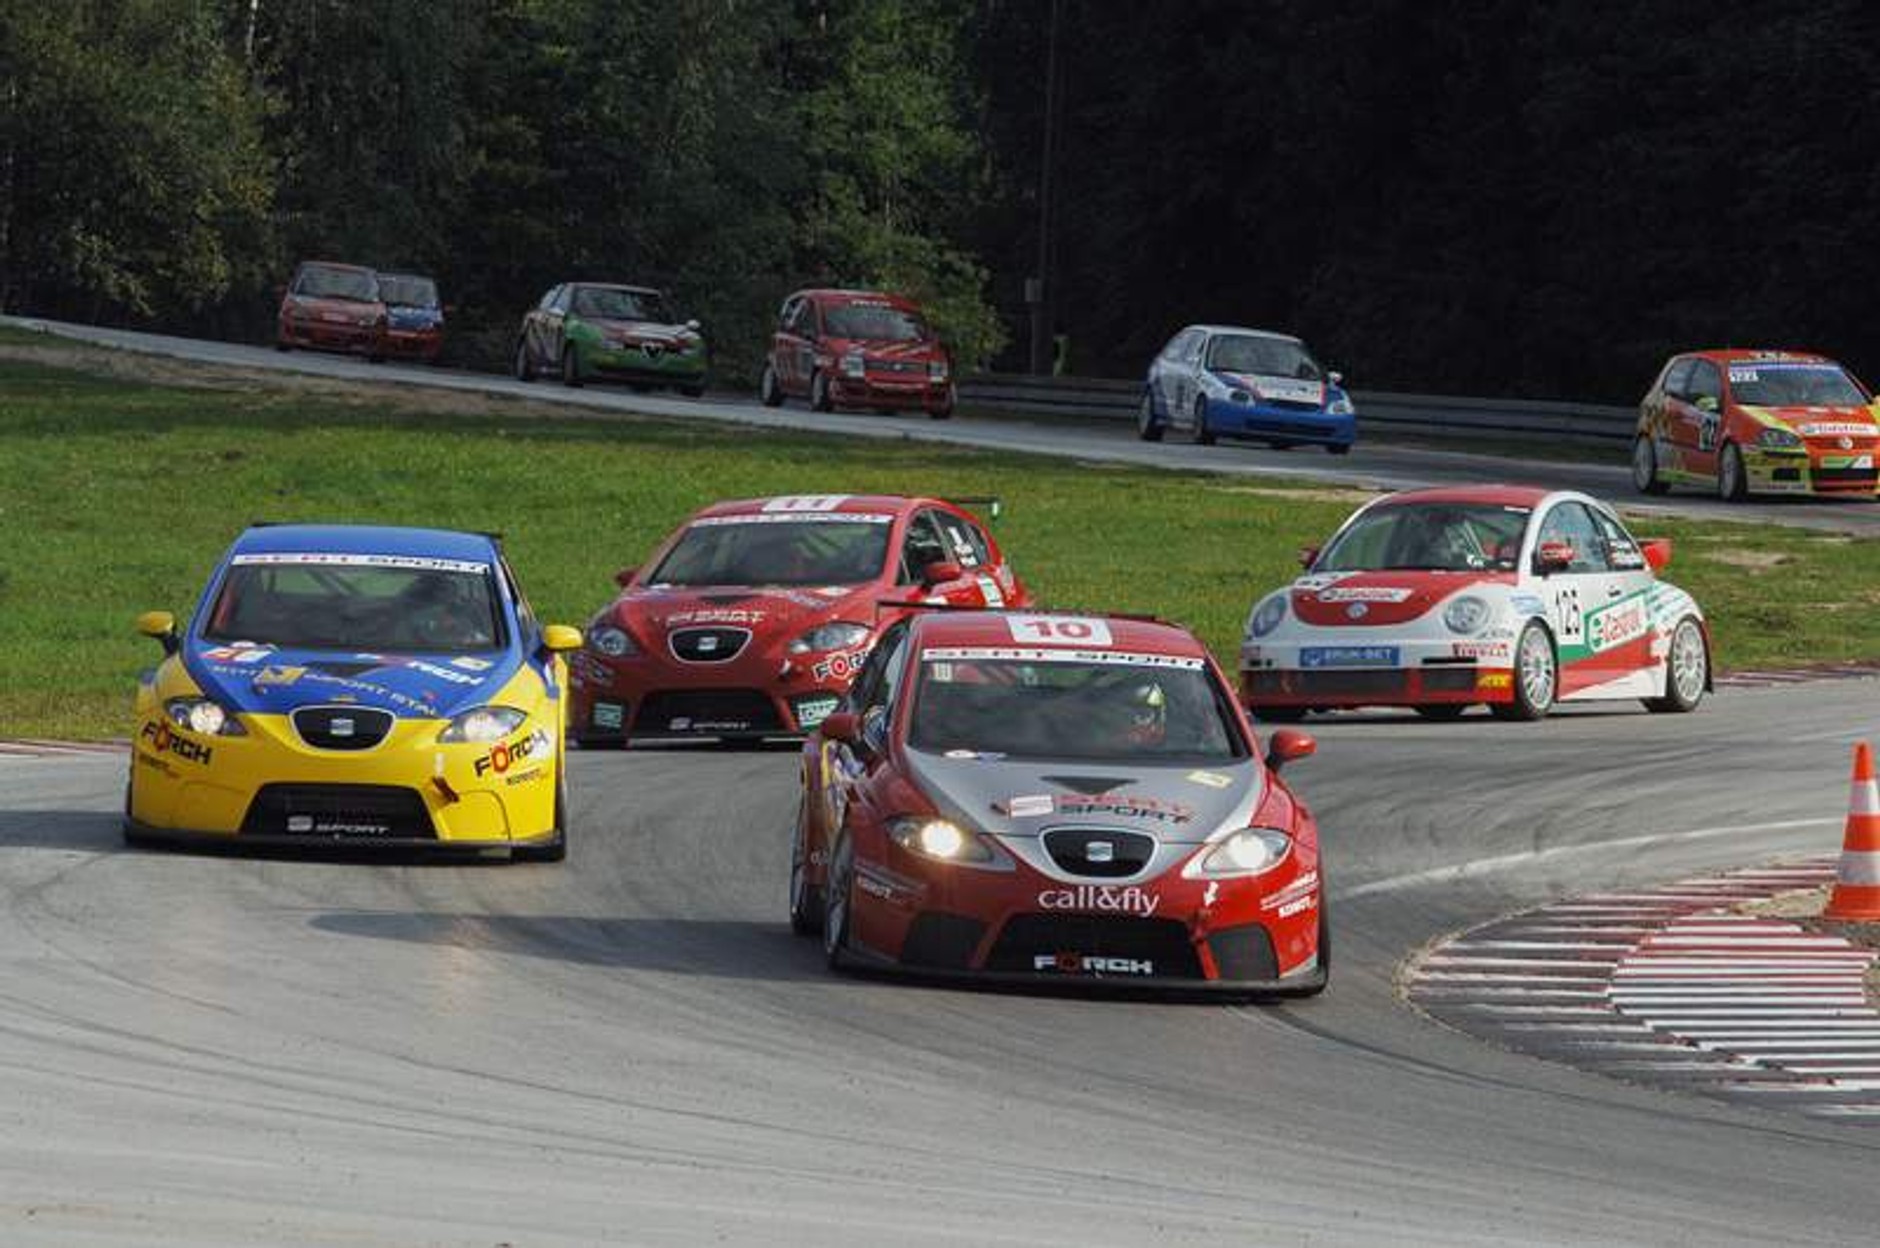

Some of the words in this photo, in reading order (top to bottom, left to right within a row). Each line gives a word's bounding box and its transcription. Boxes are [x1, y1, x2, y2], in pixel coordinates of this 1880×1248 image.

[1555, 587, 1581, 635] 125
[1025, 620, 1092, 639] 10
[1038, 885, 1160, 918] call&fly
